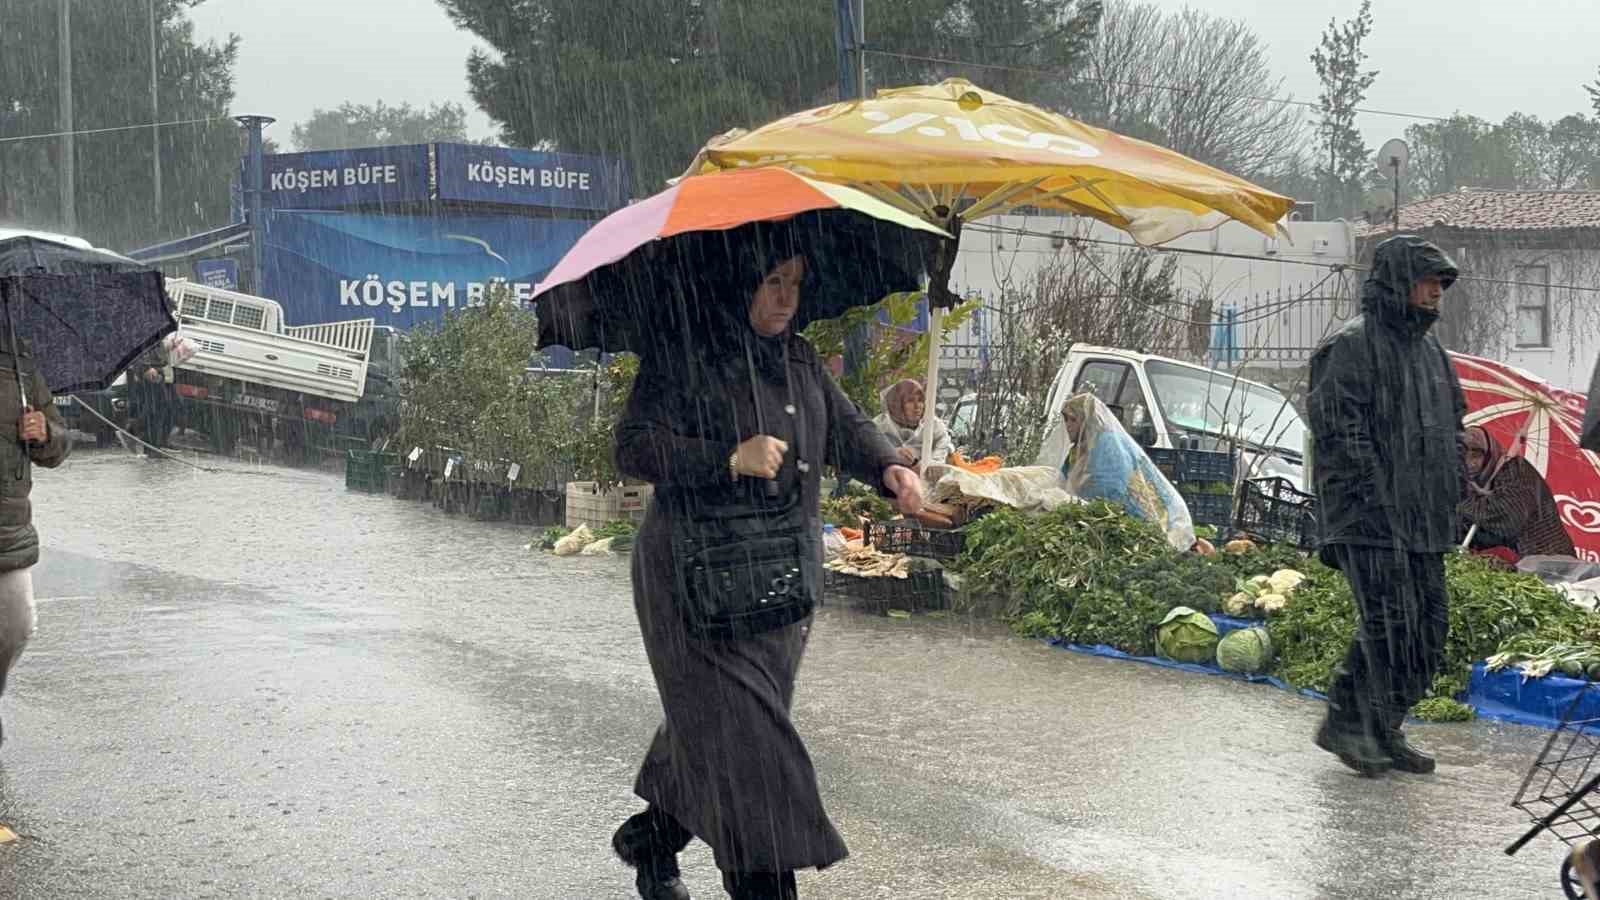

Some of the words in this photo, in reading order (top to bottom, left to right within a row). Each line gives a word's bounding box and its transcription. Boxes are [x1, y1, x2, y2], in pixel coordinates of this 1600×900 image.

[271, 168, 338, 192] KÖŞEM
[343, 163, 397, 186] BÜFE
[467, 160, 535, 188] KÖŞEM
[540, 166, 590, 190] BÜFE
[340, 274, 455, 312] KÖŞEM
